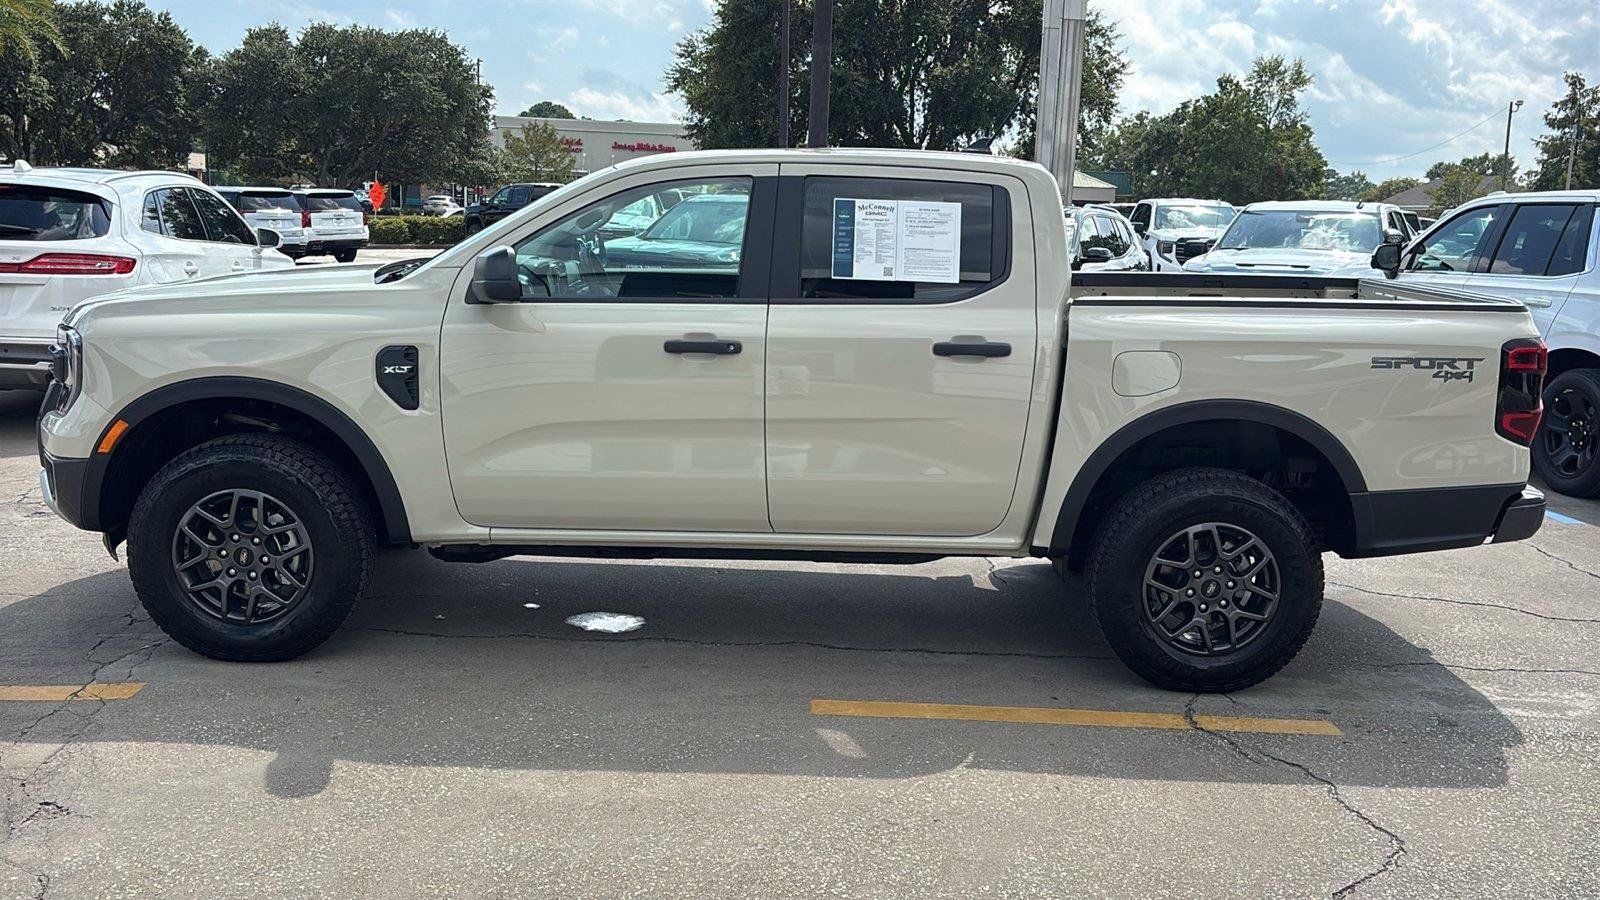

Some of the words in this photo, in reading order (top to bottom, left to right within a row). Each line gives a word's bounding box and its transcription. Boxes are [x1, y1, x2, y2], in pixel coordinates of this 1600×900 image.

[858, 203, 895, 212] McConnell
[1371, 356, 1485, 369] SPORT
[384, 365, 413, 374] XLT
[1432, 370, 1474, 383] 4x4
